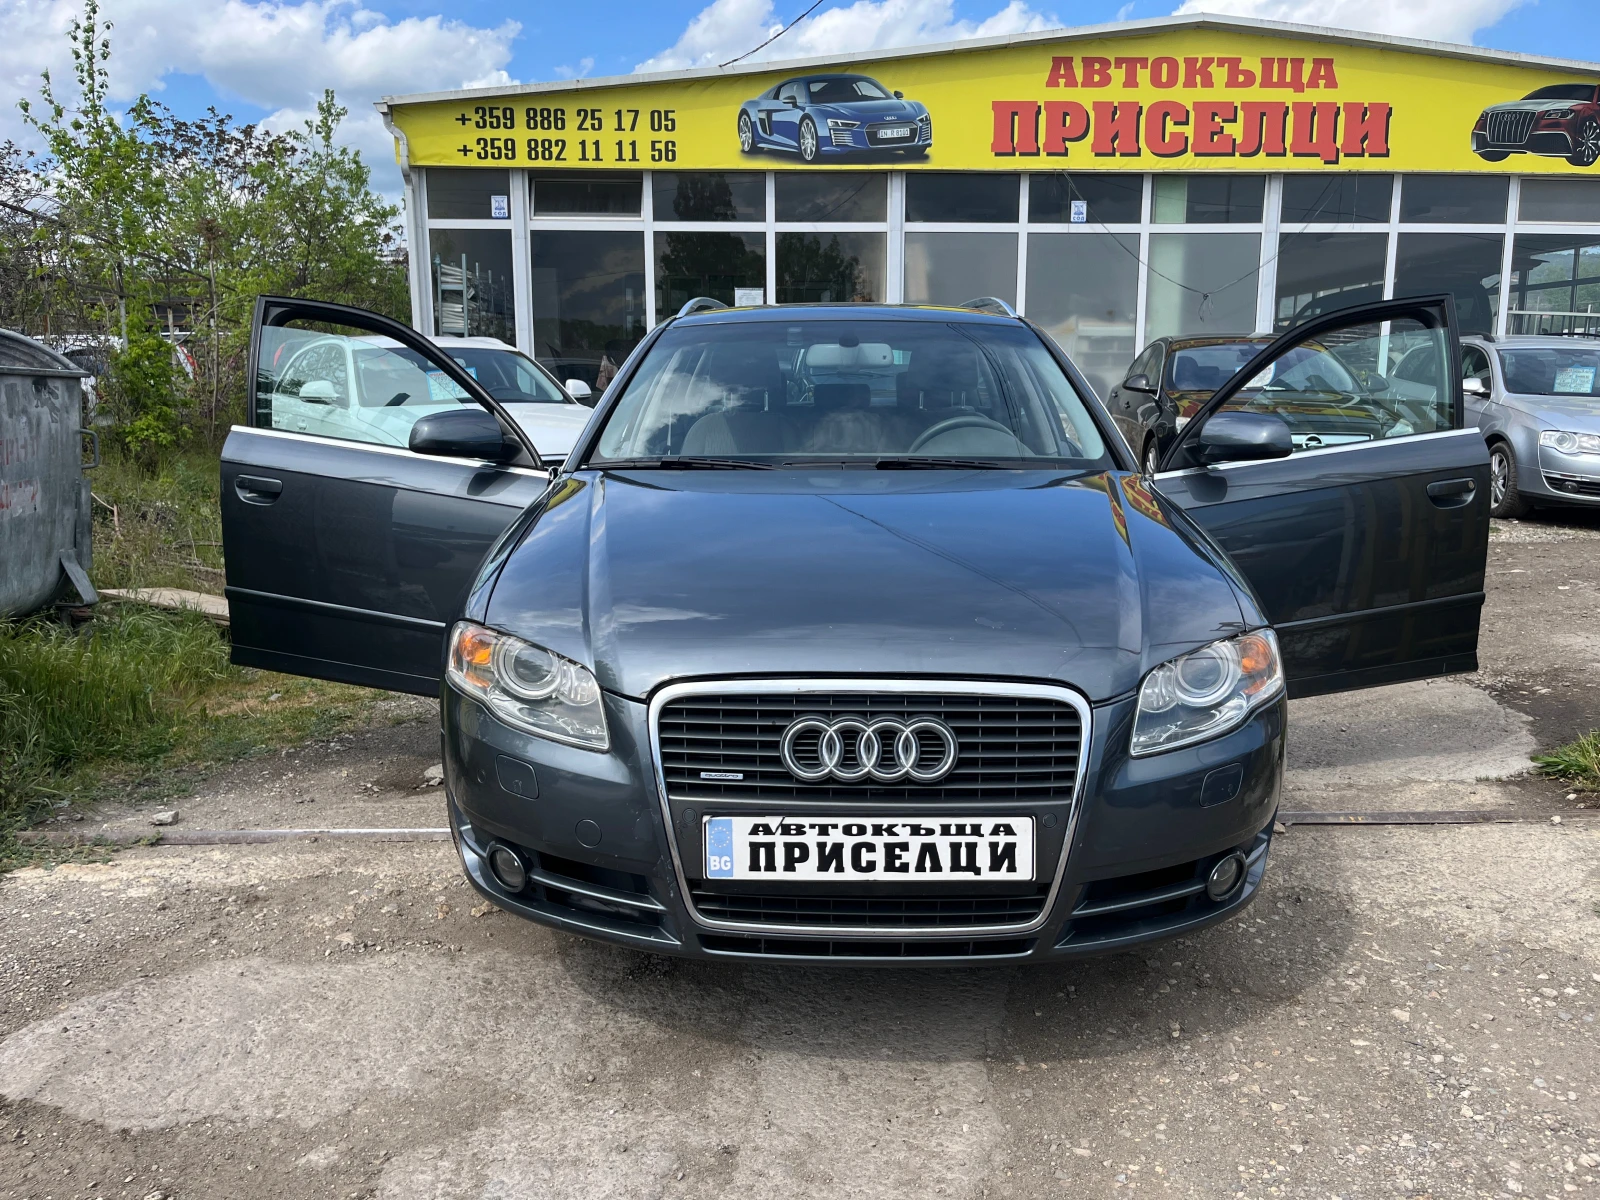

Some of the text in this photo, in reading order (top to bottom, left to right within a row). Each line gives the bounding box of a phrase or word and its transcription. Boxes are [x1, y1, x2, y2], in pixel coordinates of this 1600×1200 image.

[1045, 56, 1338, 93] АВТОКЪЩА
[455, 106, 676, 132] +359 886 25 17 05
[991, 100, 1392, 164] ПРИСЕЛЦИ
[457, 137, 676, 162] +359 882 11 11 56
[748, 822, 1017, 838] АВТОКЪЩА
[709, 855, 732, 871] BG
[748, 841, 1018, 876] ПРИСЕЛЦИ
